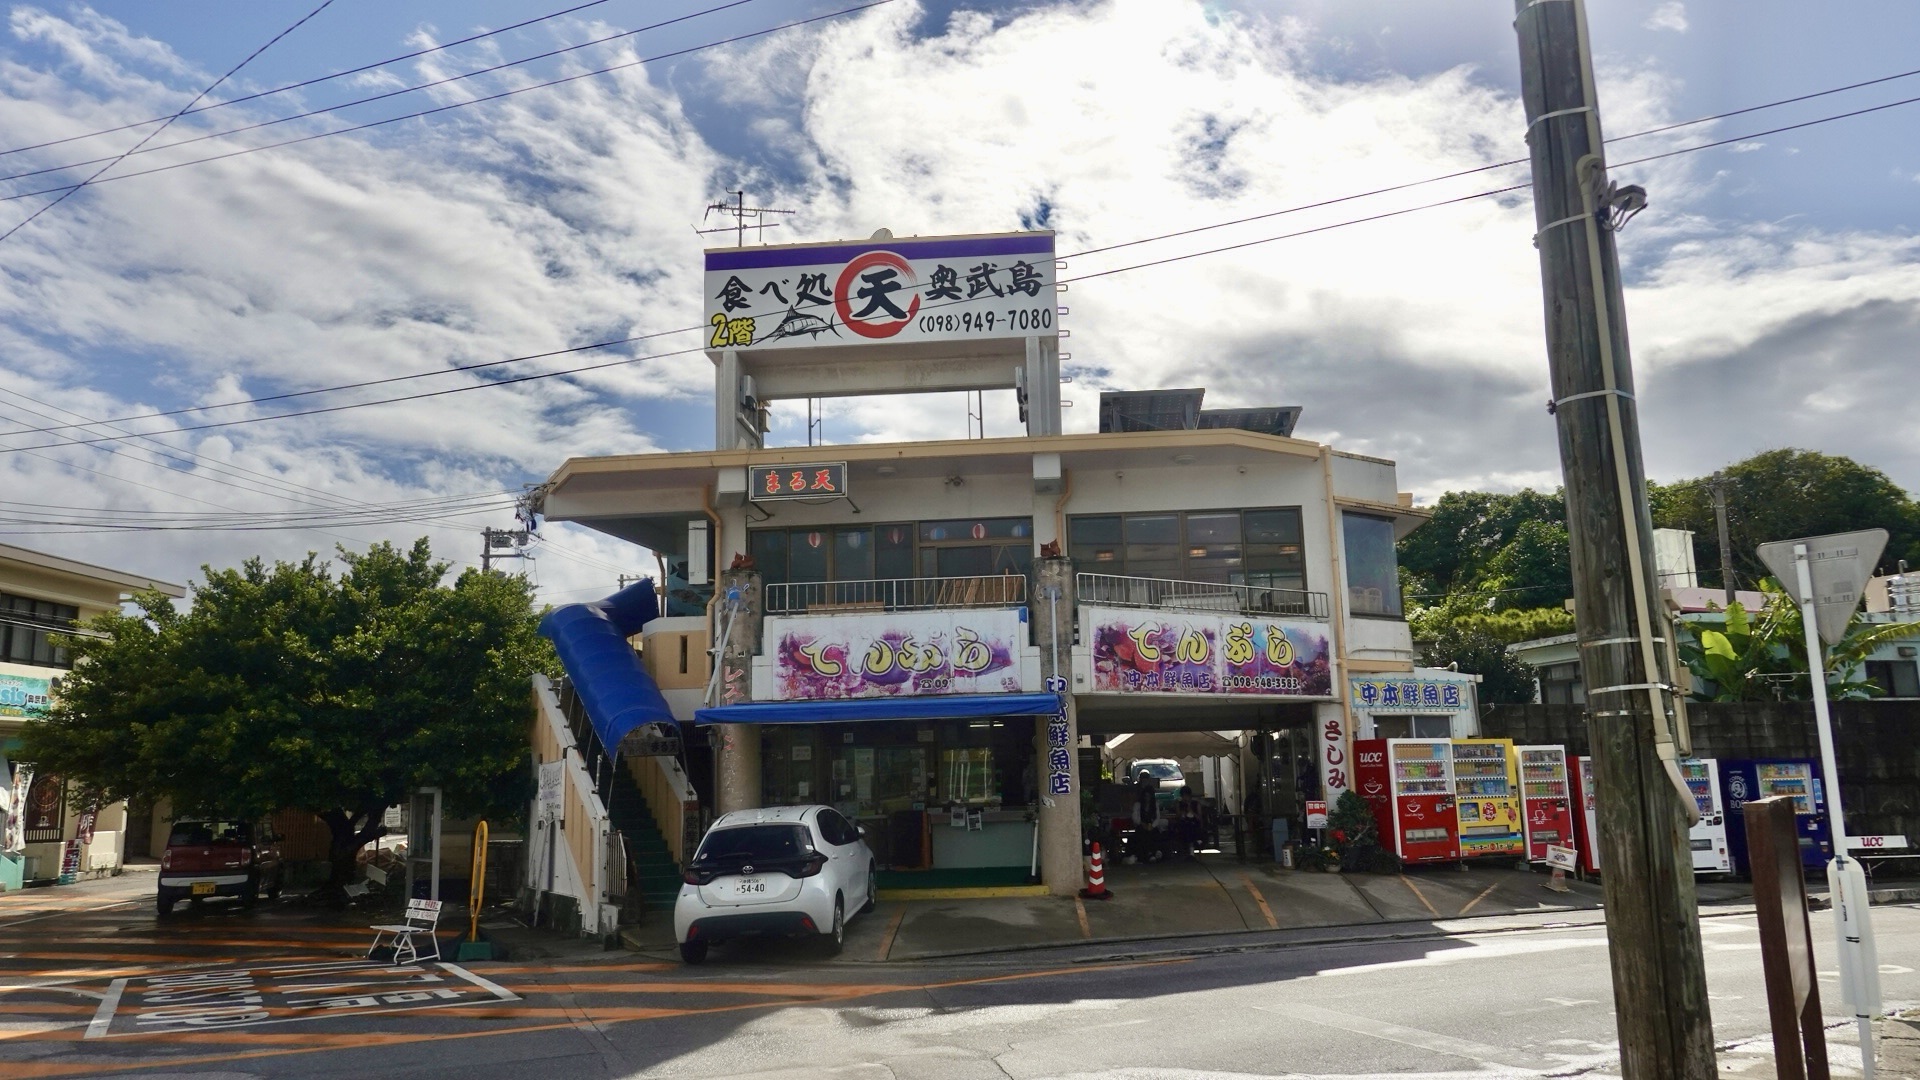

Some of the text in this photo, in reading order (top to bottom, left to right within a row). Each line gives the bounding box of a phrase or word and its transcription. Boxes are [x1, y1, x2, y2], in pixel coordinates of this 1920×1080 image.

[714, 273, 833, 313] 食べ処
[925, 260, 1043, 301] 奥武島
[711, 312, 756, 348] 2階
[919, 308, 1052, 333] (098)949-7080
[765, 469, 835, 493] まる天
[1129, 620, 1294, 666] てんぷら
[1128, 671, 1211, 689] 中本鮮魚店
[1361, 681, 1460, 707] 中本鮮魚店
[1325, 720, 1347, 788] さしみ
[1730, 799, 1751, 809] BOS
[1861, 837, 1884, 848] UCC
[741, 883, 765, 894] 54-40
